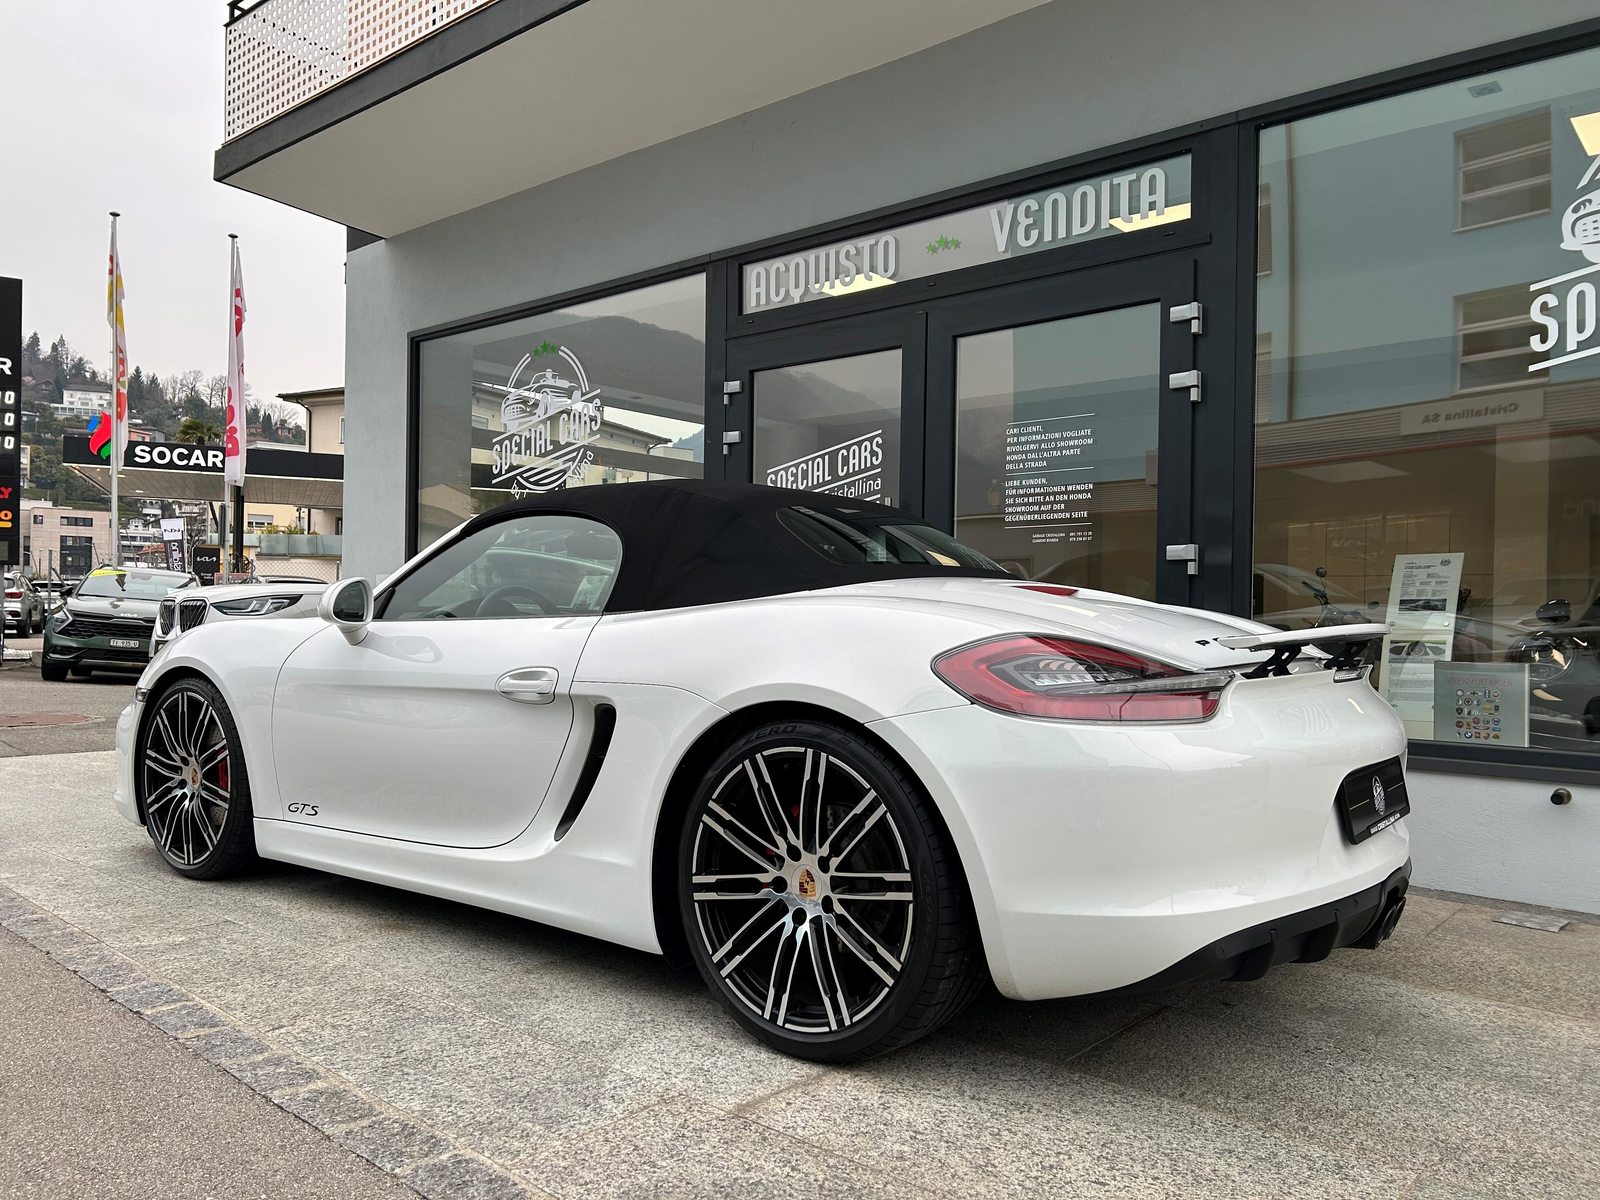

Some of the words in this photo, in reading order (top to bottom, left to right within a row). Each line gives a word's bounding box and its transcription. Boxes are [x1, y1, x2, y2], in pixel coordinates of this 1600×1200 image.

[750, 234, 898, 308] ACQUISTO
[989, 167, 1168, 254] VENDITA
[492, 420, 553, 475] SPECIAL
[559, 398, 601, 445] CARS
[1018, 432, 1061, 442] INFORMAZIONI
[1062, 428, 1092, 438] VOGLIATE
[1006, 443, 1039, 452] RIVOLGERVI
[1041, 441, 1056, 449] ALLO
[1056, 438, 1094, 448] SHOWROOM
[133, 445, 224, 468] SOCAR
[837, 436, 883, 477] CARS
[1006, 453, 1026, 461] HONDA
[1062, 448, 1081, 456] PARTE
[1024, 460, 1047, 469] STRADA
[1005, 488, 1017, 496] FÜR
[1017, 485, 1066, 495] INFORMATIONEN
[1066, 483, 1094, 491] WENDEN
[1069, 492, 1092, 500] HONDA
[1005, 505, 1039, 513] SHOWROOM
[1004, 512, 1071, 522] GEGENÜBERLIEGENDEN
[287, 802, 320, 816] GTS
